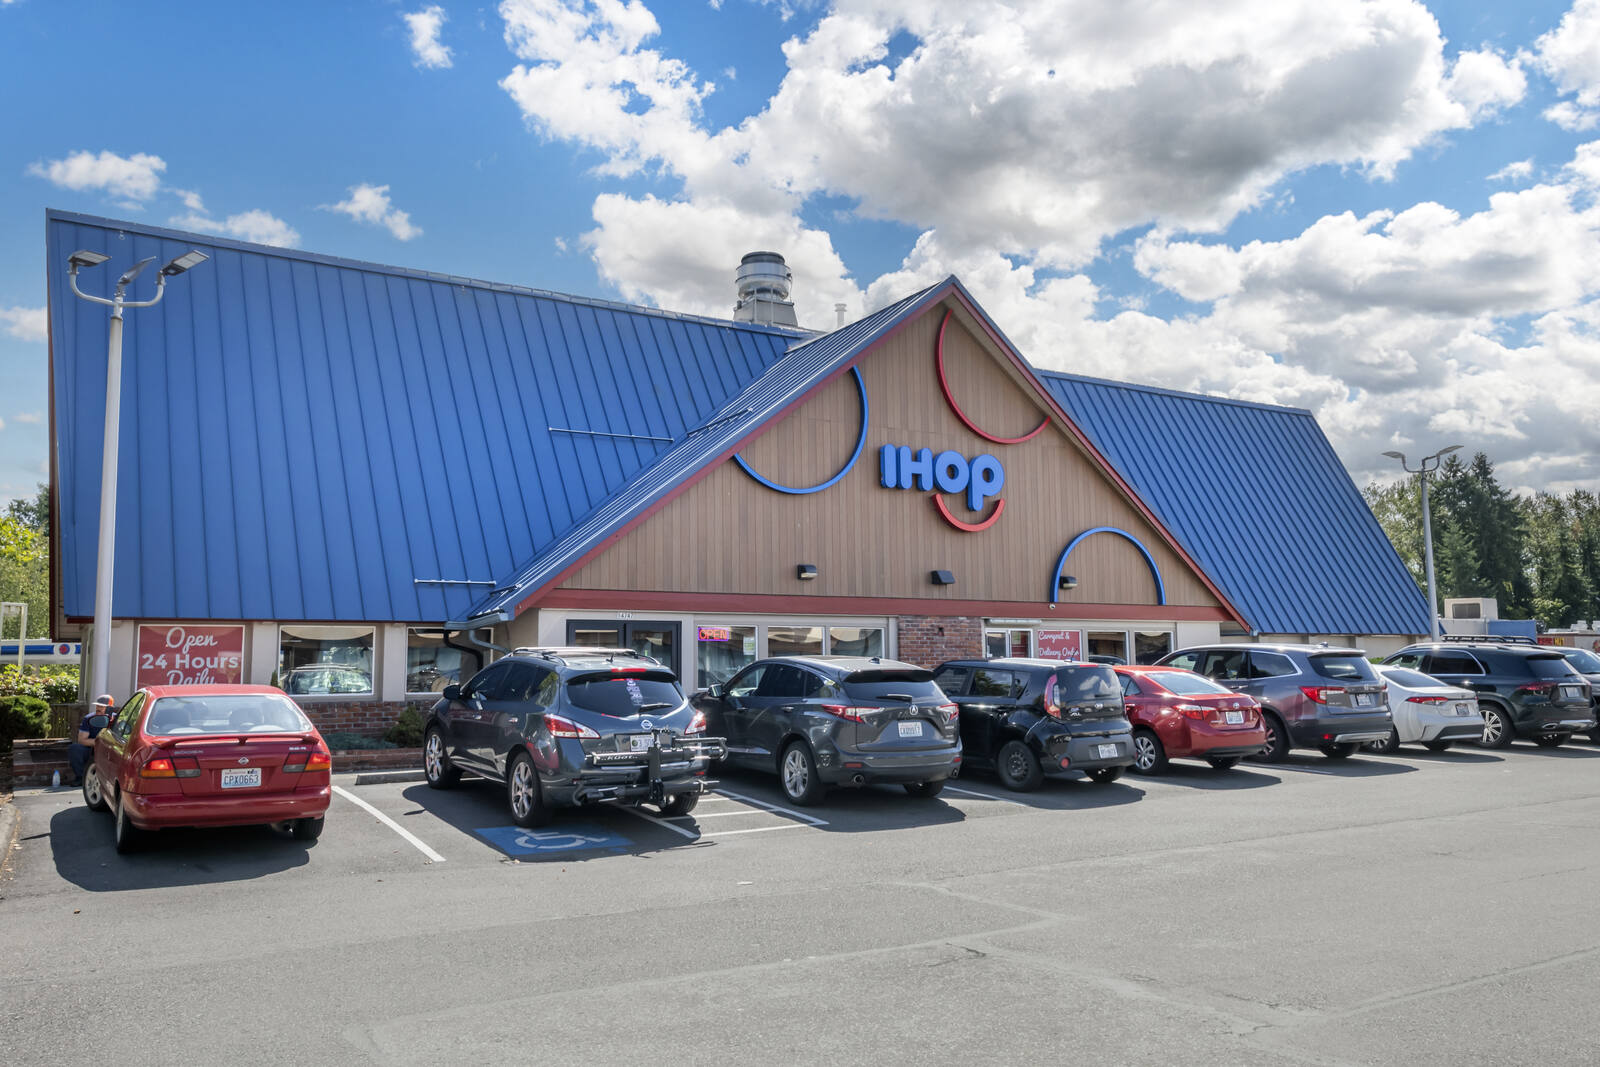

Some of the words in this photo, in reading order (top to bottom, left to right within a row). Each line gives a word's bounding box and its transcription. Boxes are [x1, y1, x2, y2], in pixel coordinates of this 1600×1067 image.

[166, 626, 218, 655] Open
[699, 629, 728, 640] OPEN
[1038, 631, 1064, 644] Carryout
[1039, 647, 1062, 660] Delivery
[141, 653, 168, 670] 24
[175, 653, 239, 670] Hours
[223, 774, 260, 785] CPX0663
